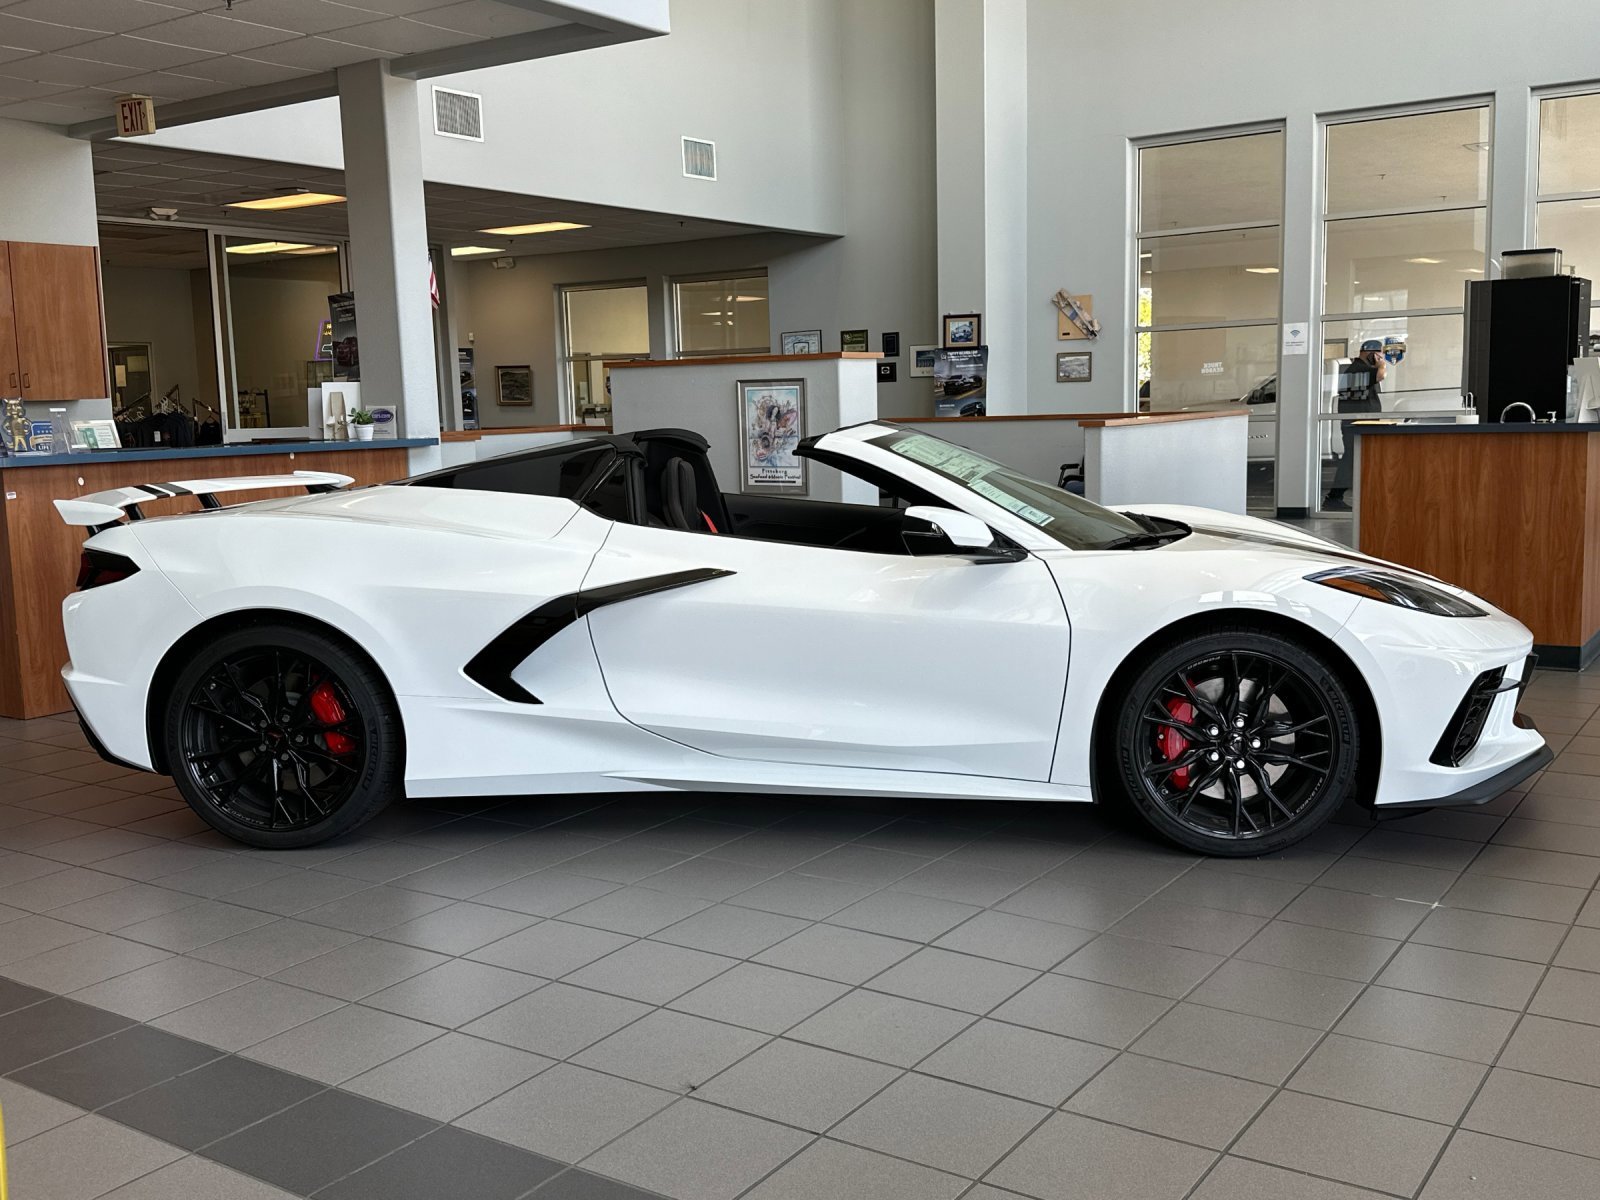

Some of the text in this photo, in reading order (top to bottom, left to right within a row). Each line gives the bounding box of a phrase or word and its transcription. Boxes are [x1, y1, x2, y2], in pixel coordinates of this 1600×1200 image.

[120, 100, 143, 132] EXIT
[1328, 690, 1351, 744] MICHELIN
[1296, 777, 1323, 814] CORVETTE
